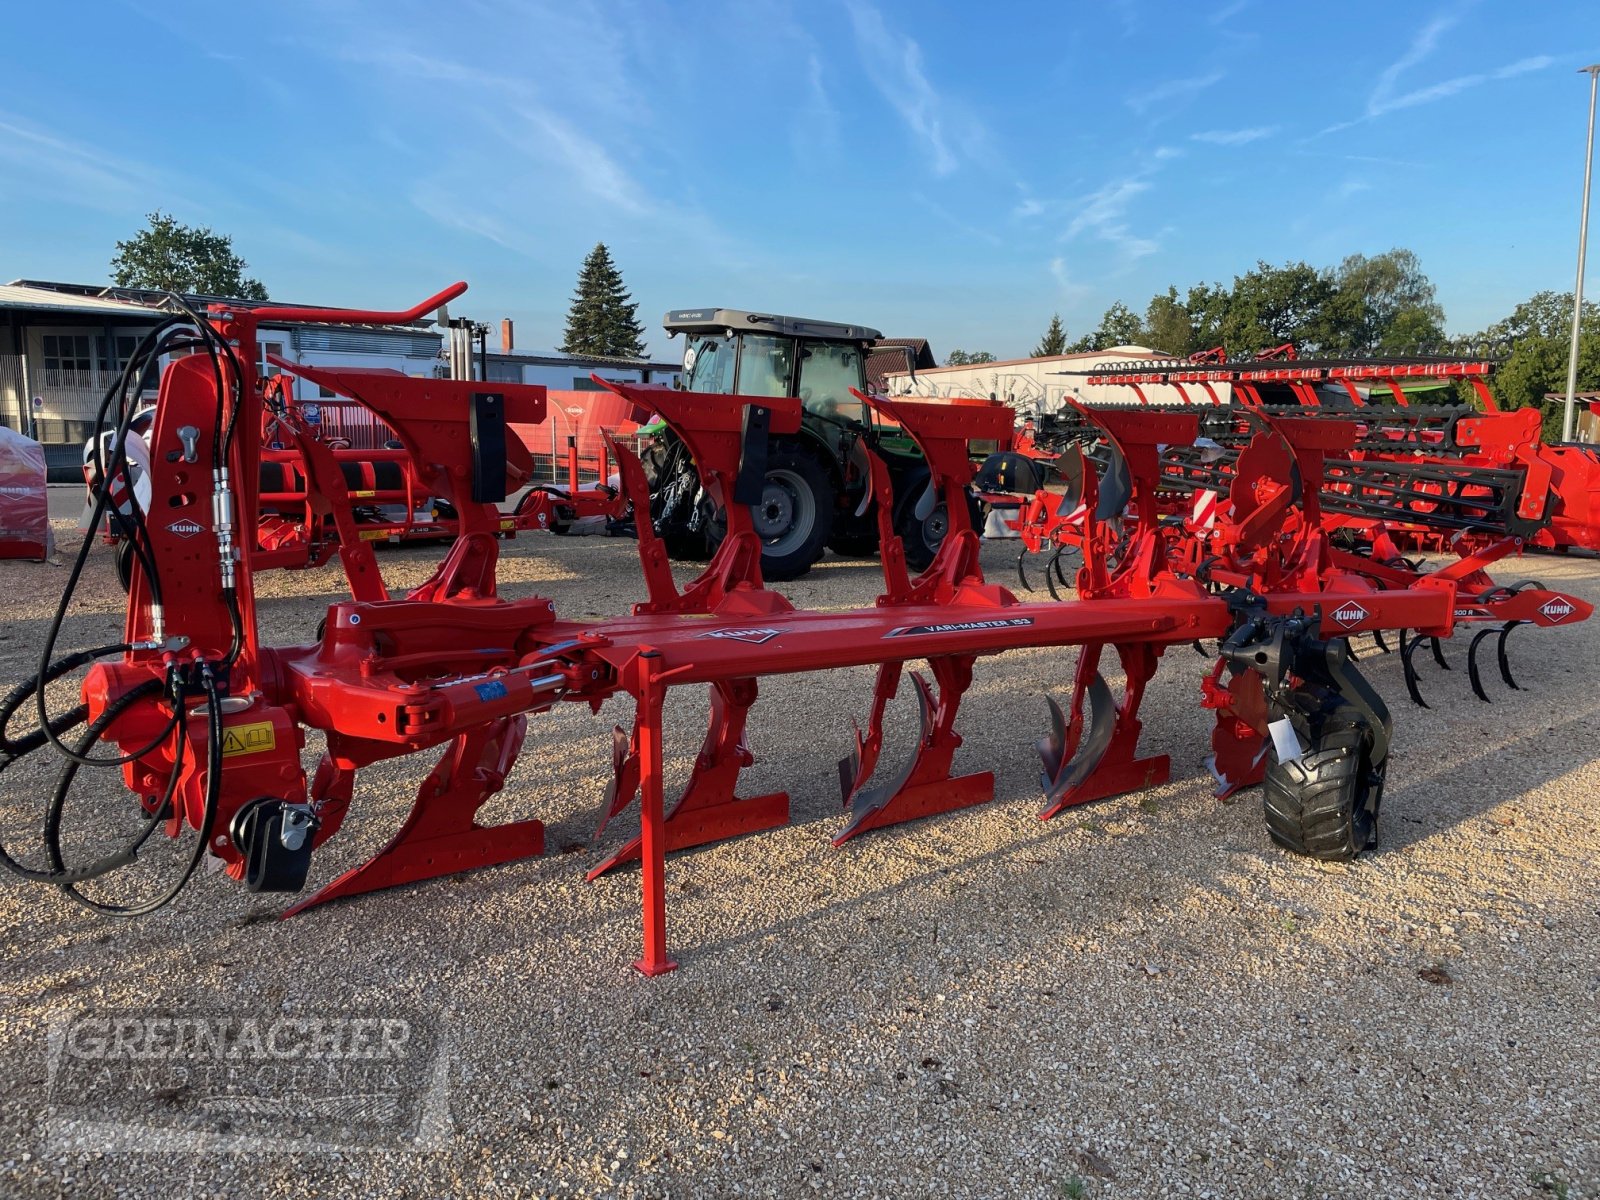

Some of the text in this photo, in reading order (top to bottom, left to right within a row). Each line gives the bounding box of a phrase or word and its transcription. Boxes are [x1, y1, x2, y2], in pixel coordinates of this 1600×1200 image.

[1336, 610, 1364, 620] KUHN
[1543, 605, 1570, 615] KUHN
[924, 618, 1031, 632] VARI-MASTER 153
[709, 628, 780, 638] KUHN
